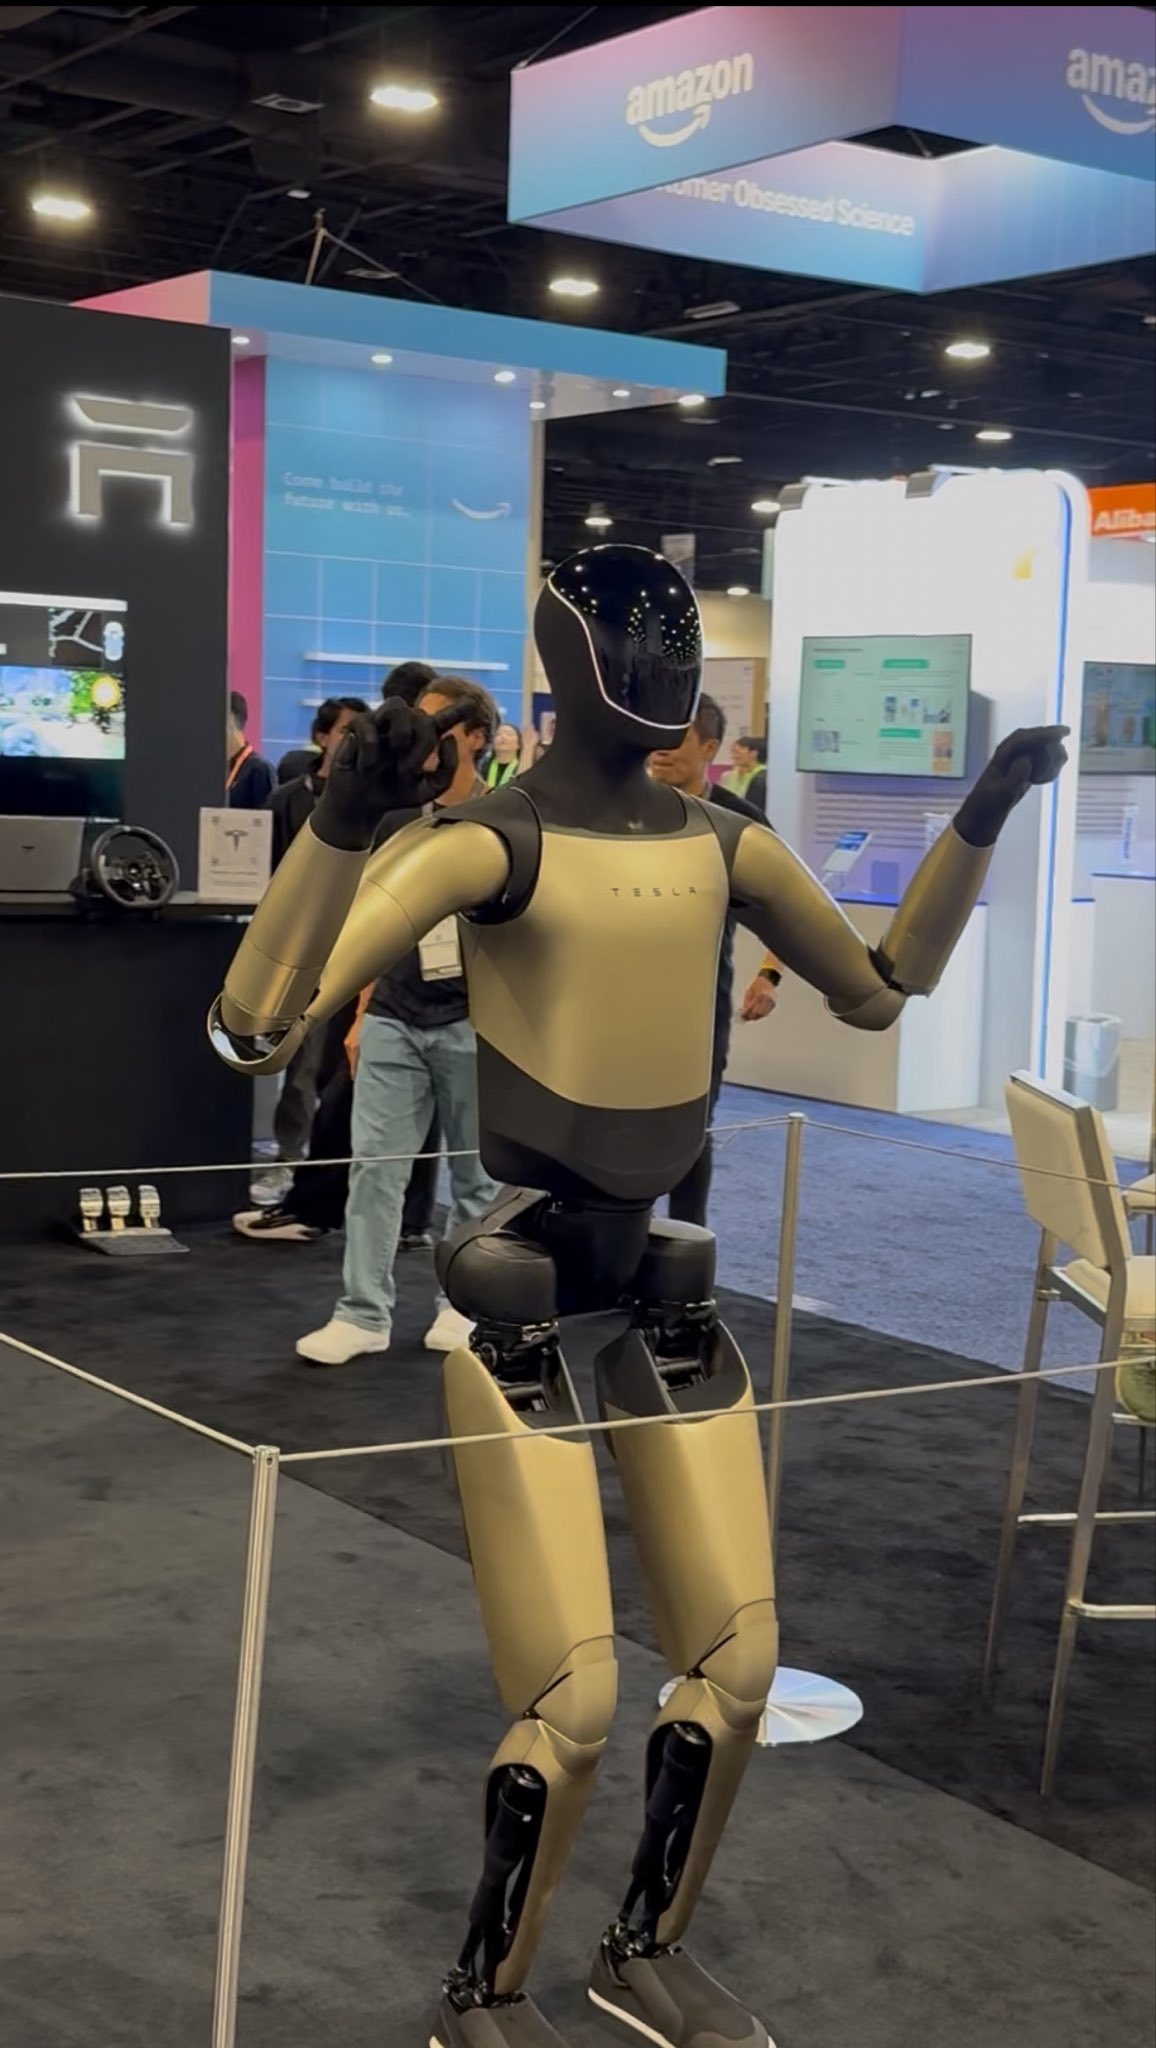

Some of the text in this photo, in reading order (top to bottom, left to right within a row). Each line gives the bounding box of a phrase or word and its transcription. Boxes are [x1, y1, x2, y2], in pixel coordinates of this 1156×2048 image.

[625, 53, 753, 125] amazon
[733, 180, 833, 222] Obsessed
[837, 198, 914, 235] Science
[283, 471, 403, 496] Come build the
[284, 491, 334, 509] future
[341, 500, 380, 513] with
[611, 886, 697, 898] TESLA
